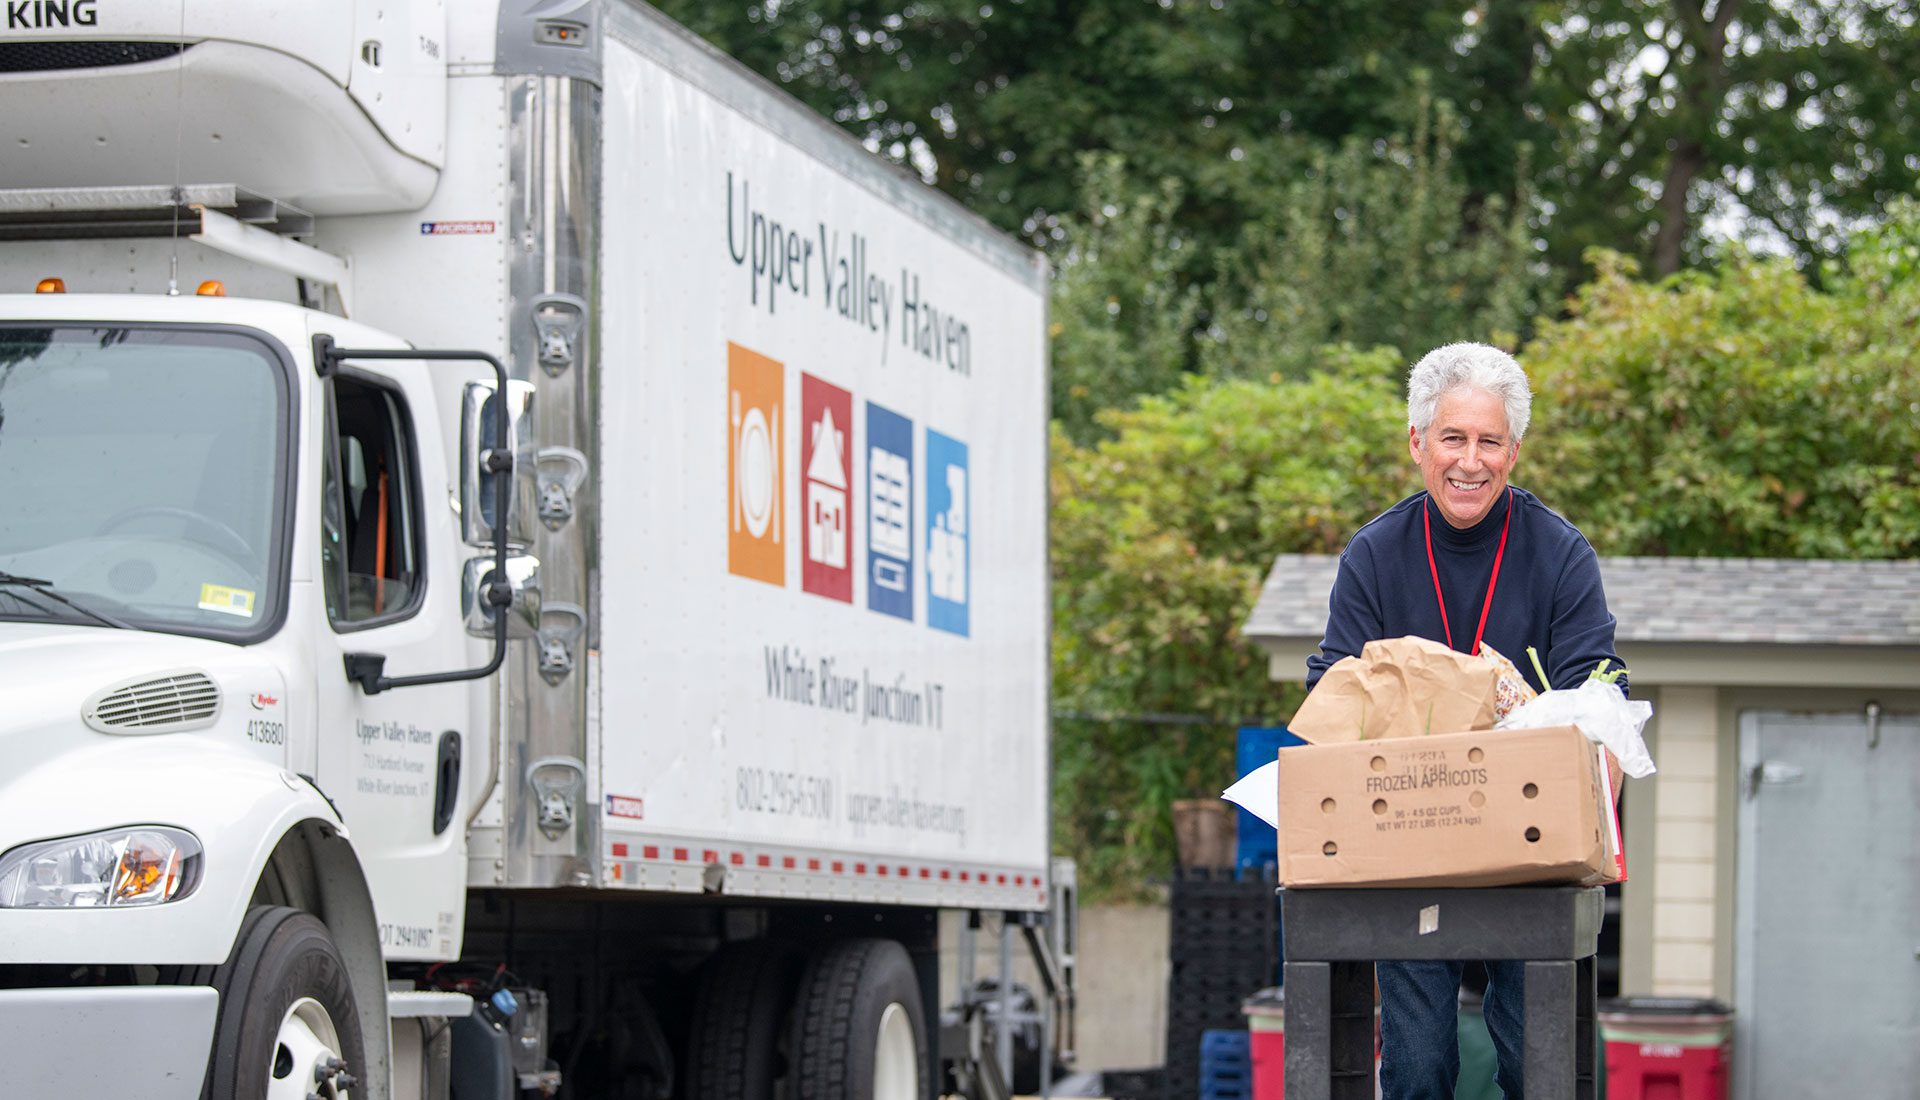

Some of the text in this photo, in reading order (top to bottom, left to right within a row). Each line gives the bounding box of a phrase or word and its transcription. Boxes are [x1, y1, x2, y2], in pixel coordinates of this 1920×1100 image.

[8, 0, 98, 29] KING
[727, 172, 971, 377] Upper Valley Haven
[764, 645, 944, 730] White River Junction VT
[247, 719, 285, 746] 413680
[356, 717, 432, 750] Upper Valley Haven
[1366, 773, 1418, 793] FROZEN
[1421, 768, 1488, 789] APRICOTS
[1375, 822, 1391, 832] NET
[1393, 820, 1406, 830] WT
[1408, 819, 1418, 830] 27
[1420, 818, 1436, 829] LBS
[1426, 807, 1438, 817] OZ
[1439, 805, 1462, 816] CUPS
